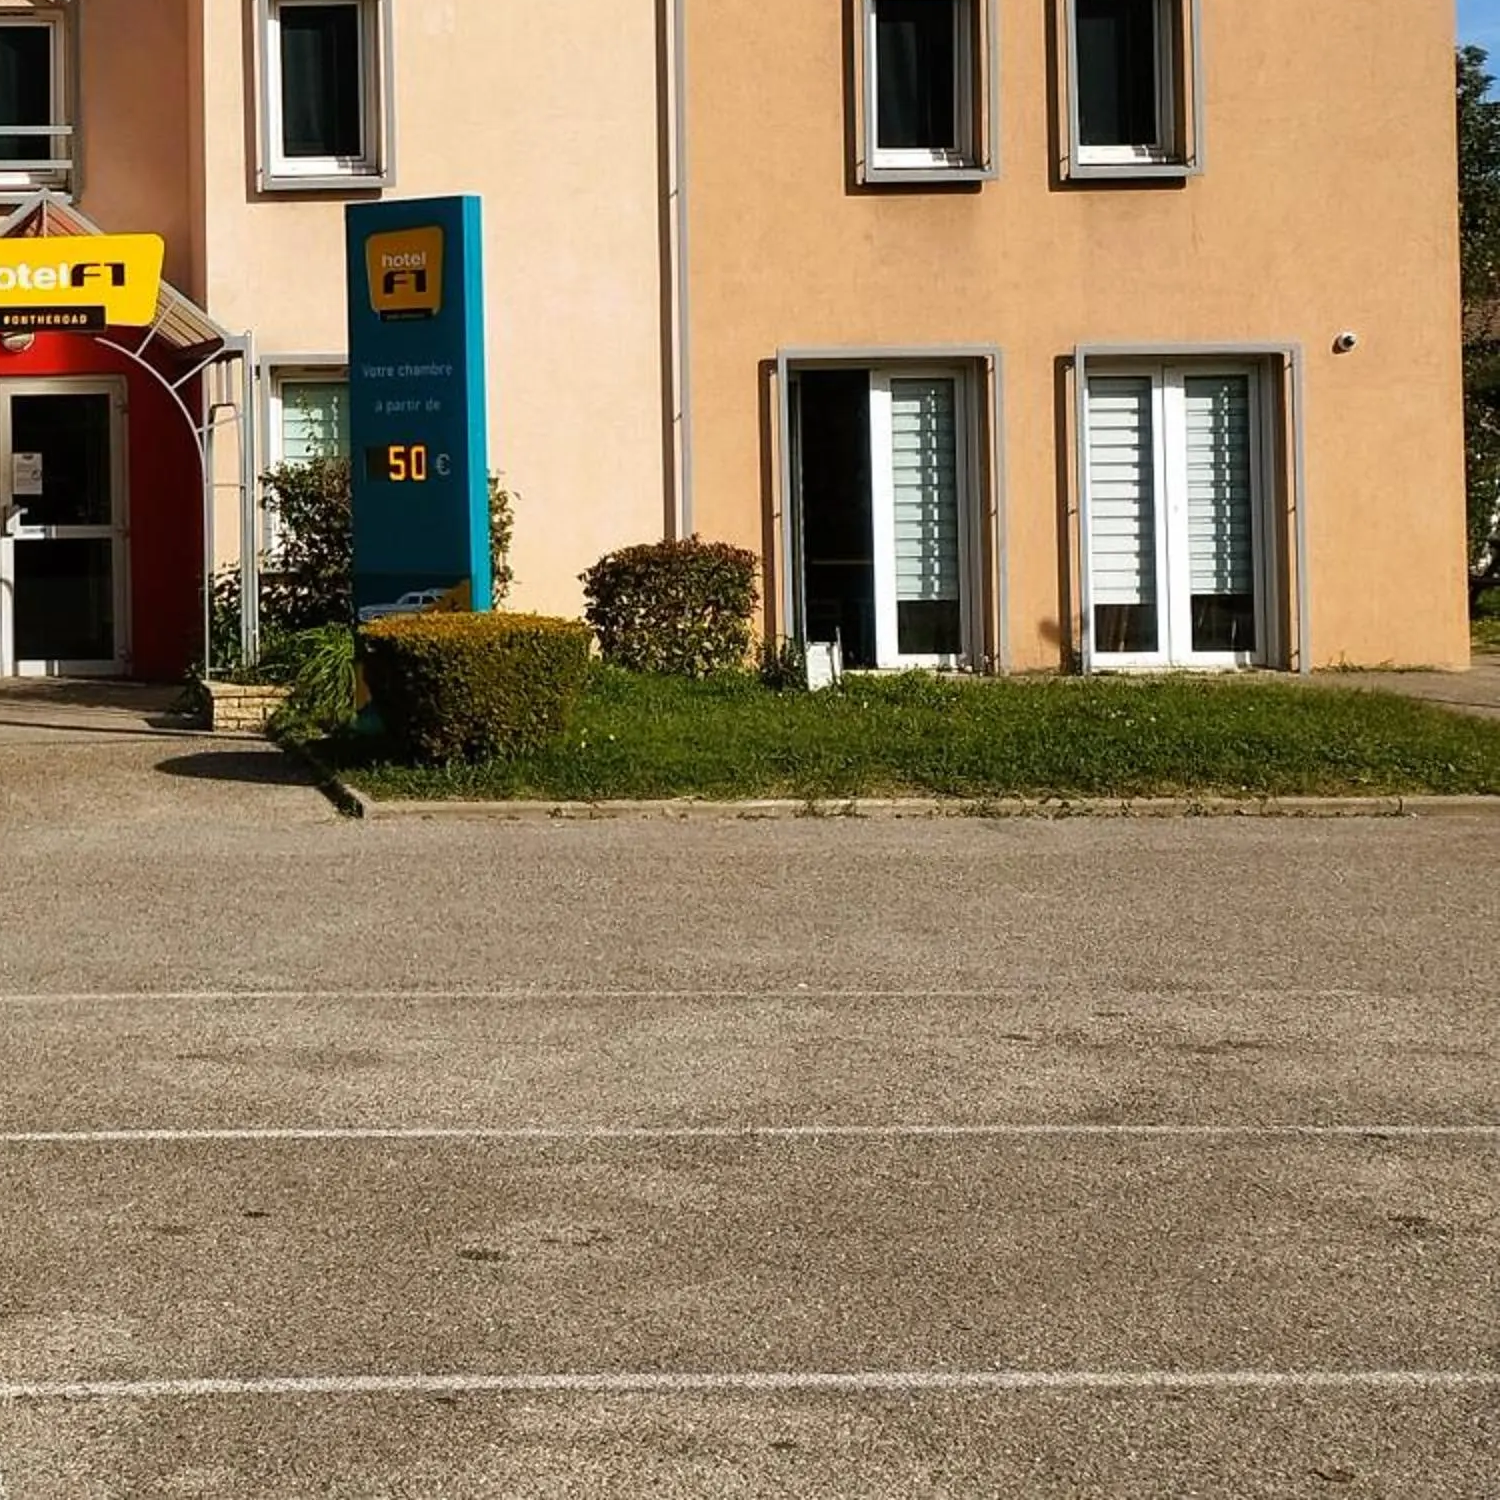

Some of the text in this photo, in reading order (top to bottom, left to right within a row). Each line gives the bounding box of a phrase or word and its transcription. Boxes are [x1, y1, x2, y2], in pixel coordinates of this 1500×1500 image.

[381, 251, 427, 268] hotel
[397, 362, 453, 377] chambre
[385, 399, 421, 414] partir
[425, 397, 441, 412] de
[389, 445, 451, 481] 50 €
